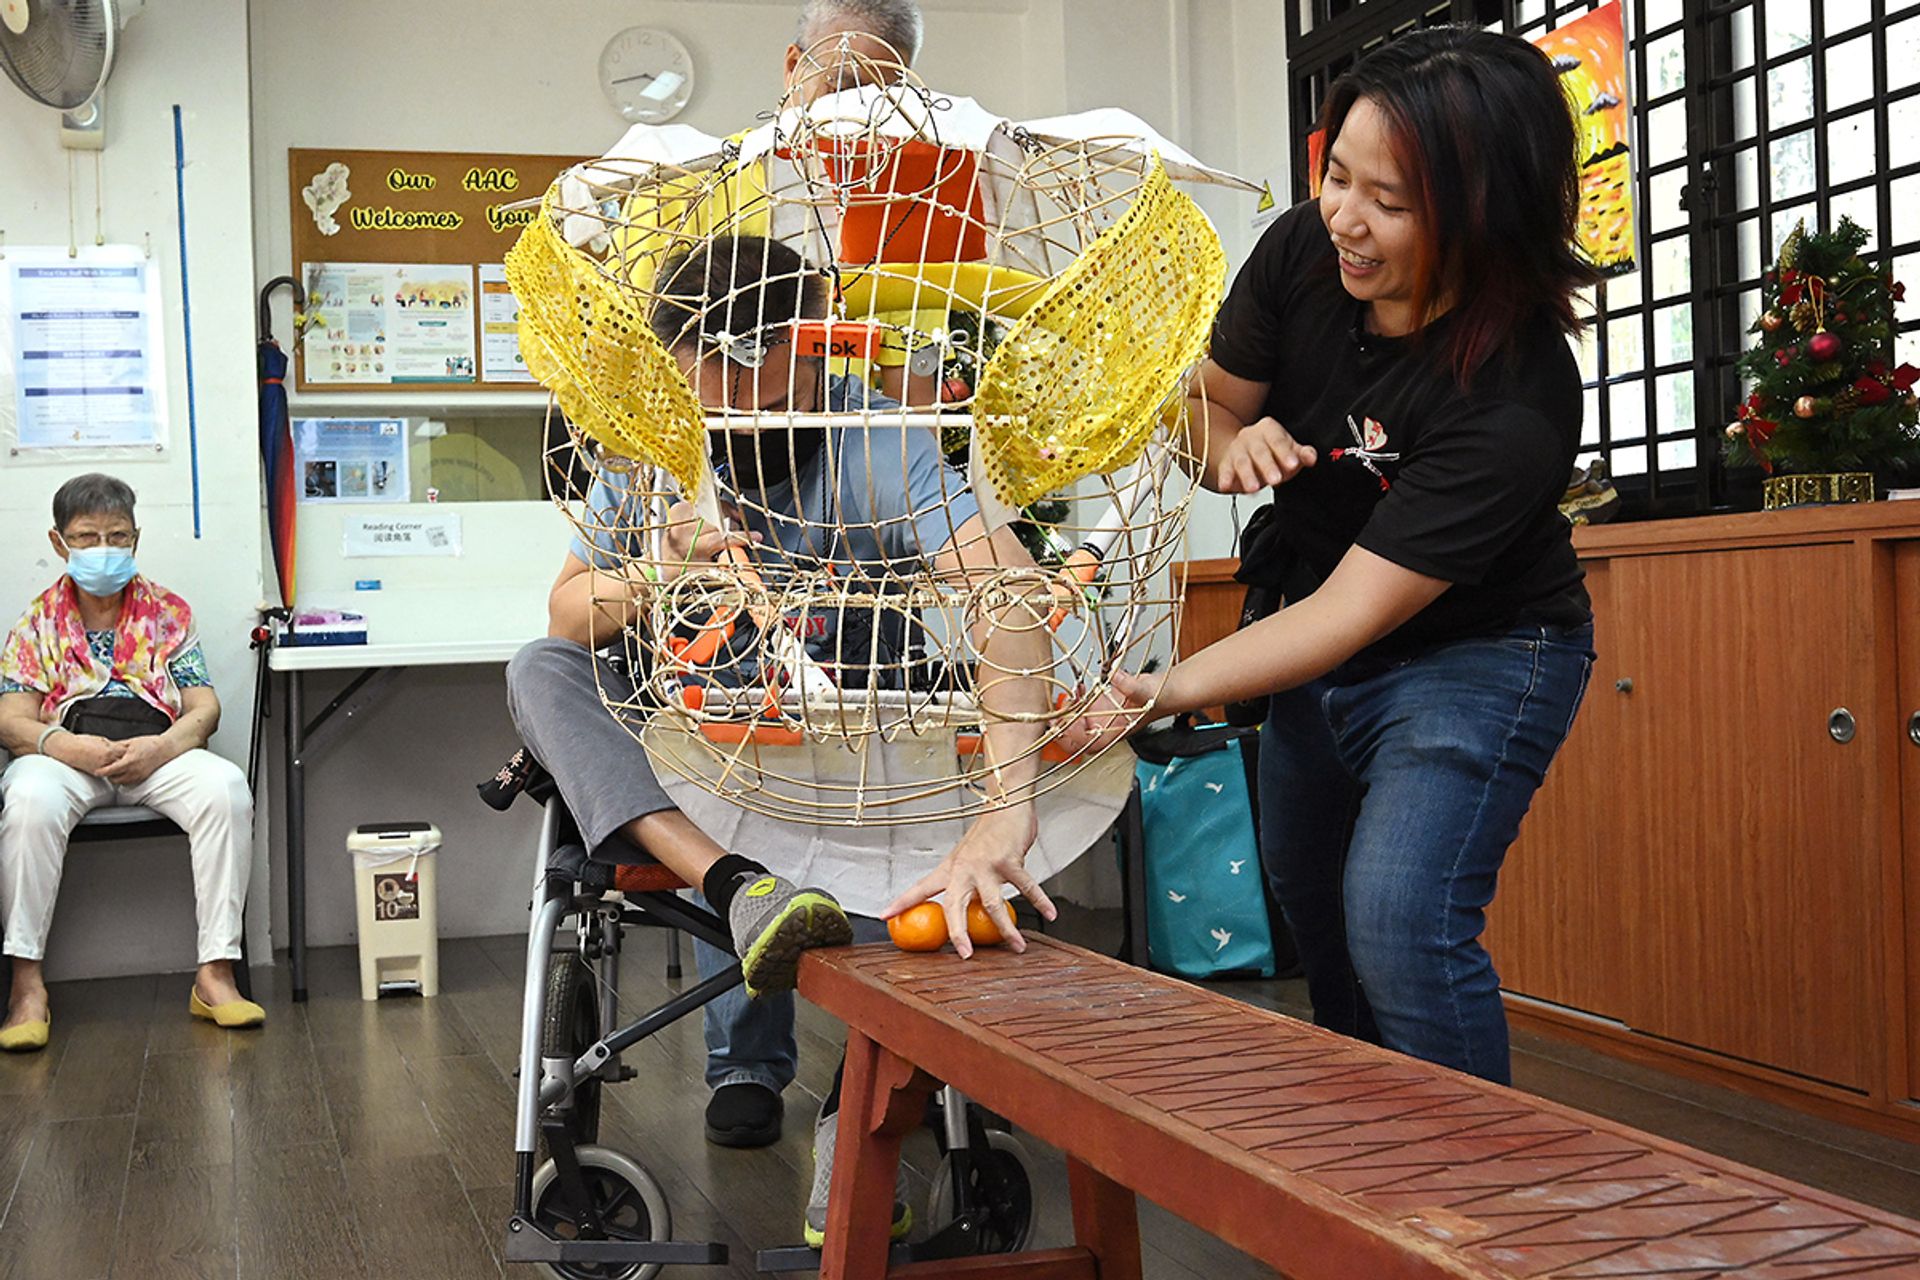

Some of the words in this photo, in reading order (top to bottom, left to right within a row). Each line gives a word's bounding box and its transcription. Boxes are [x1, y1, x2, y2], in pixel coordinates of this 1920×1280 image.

[388, 168, 435, 190] Our
[464, 168, 518, 190] AAC
[352, 207, 461, 229] Welcomes
[487, 206, 535, 231] You
[812, 340, 857, 357] nok
[362, 523, 394, 532] Reading
[395, 522, 423, 531] Corner
[373, 532, 412, 543] 阅读角落
[376, 901, 399, 919] 10
